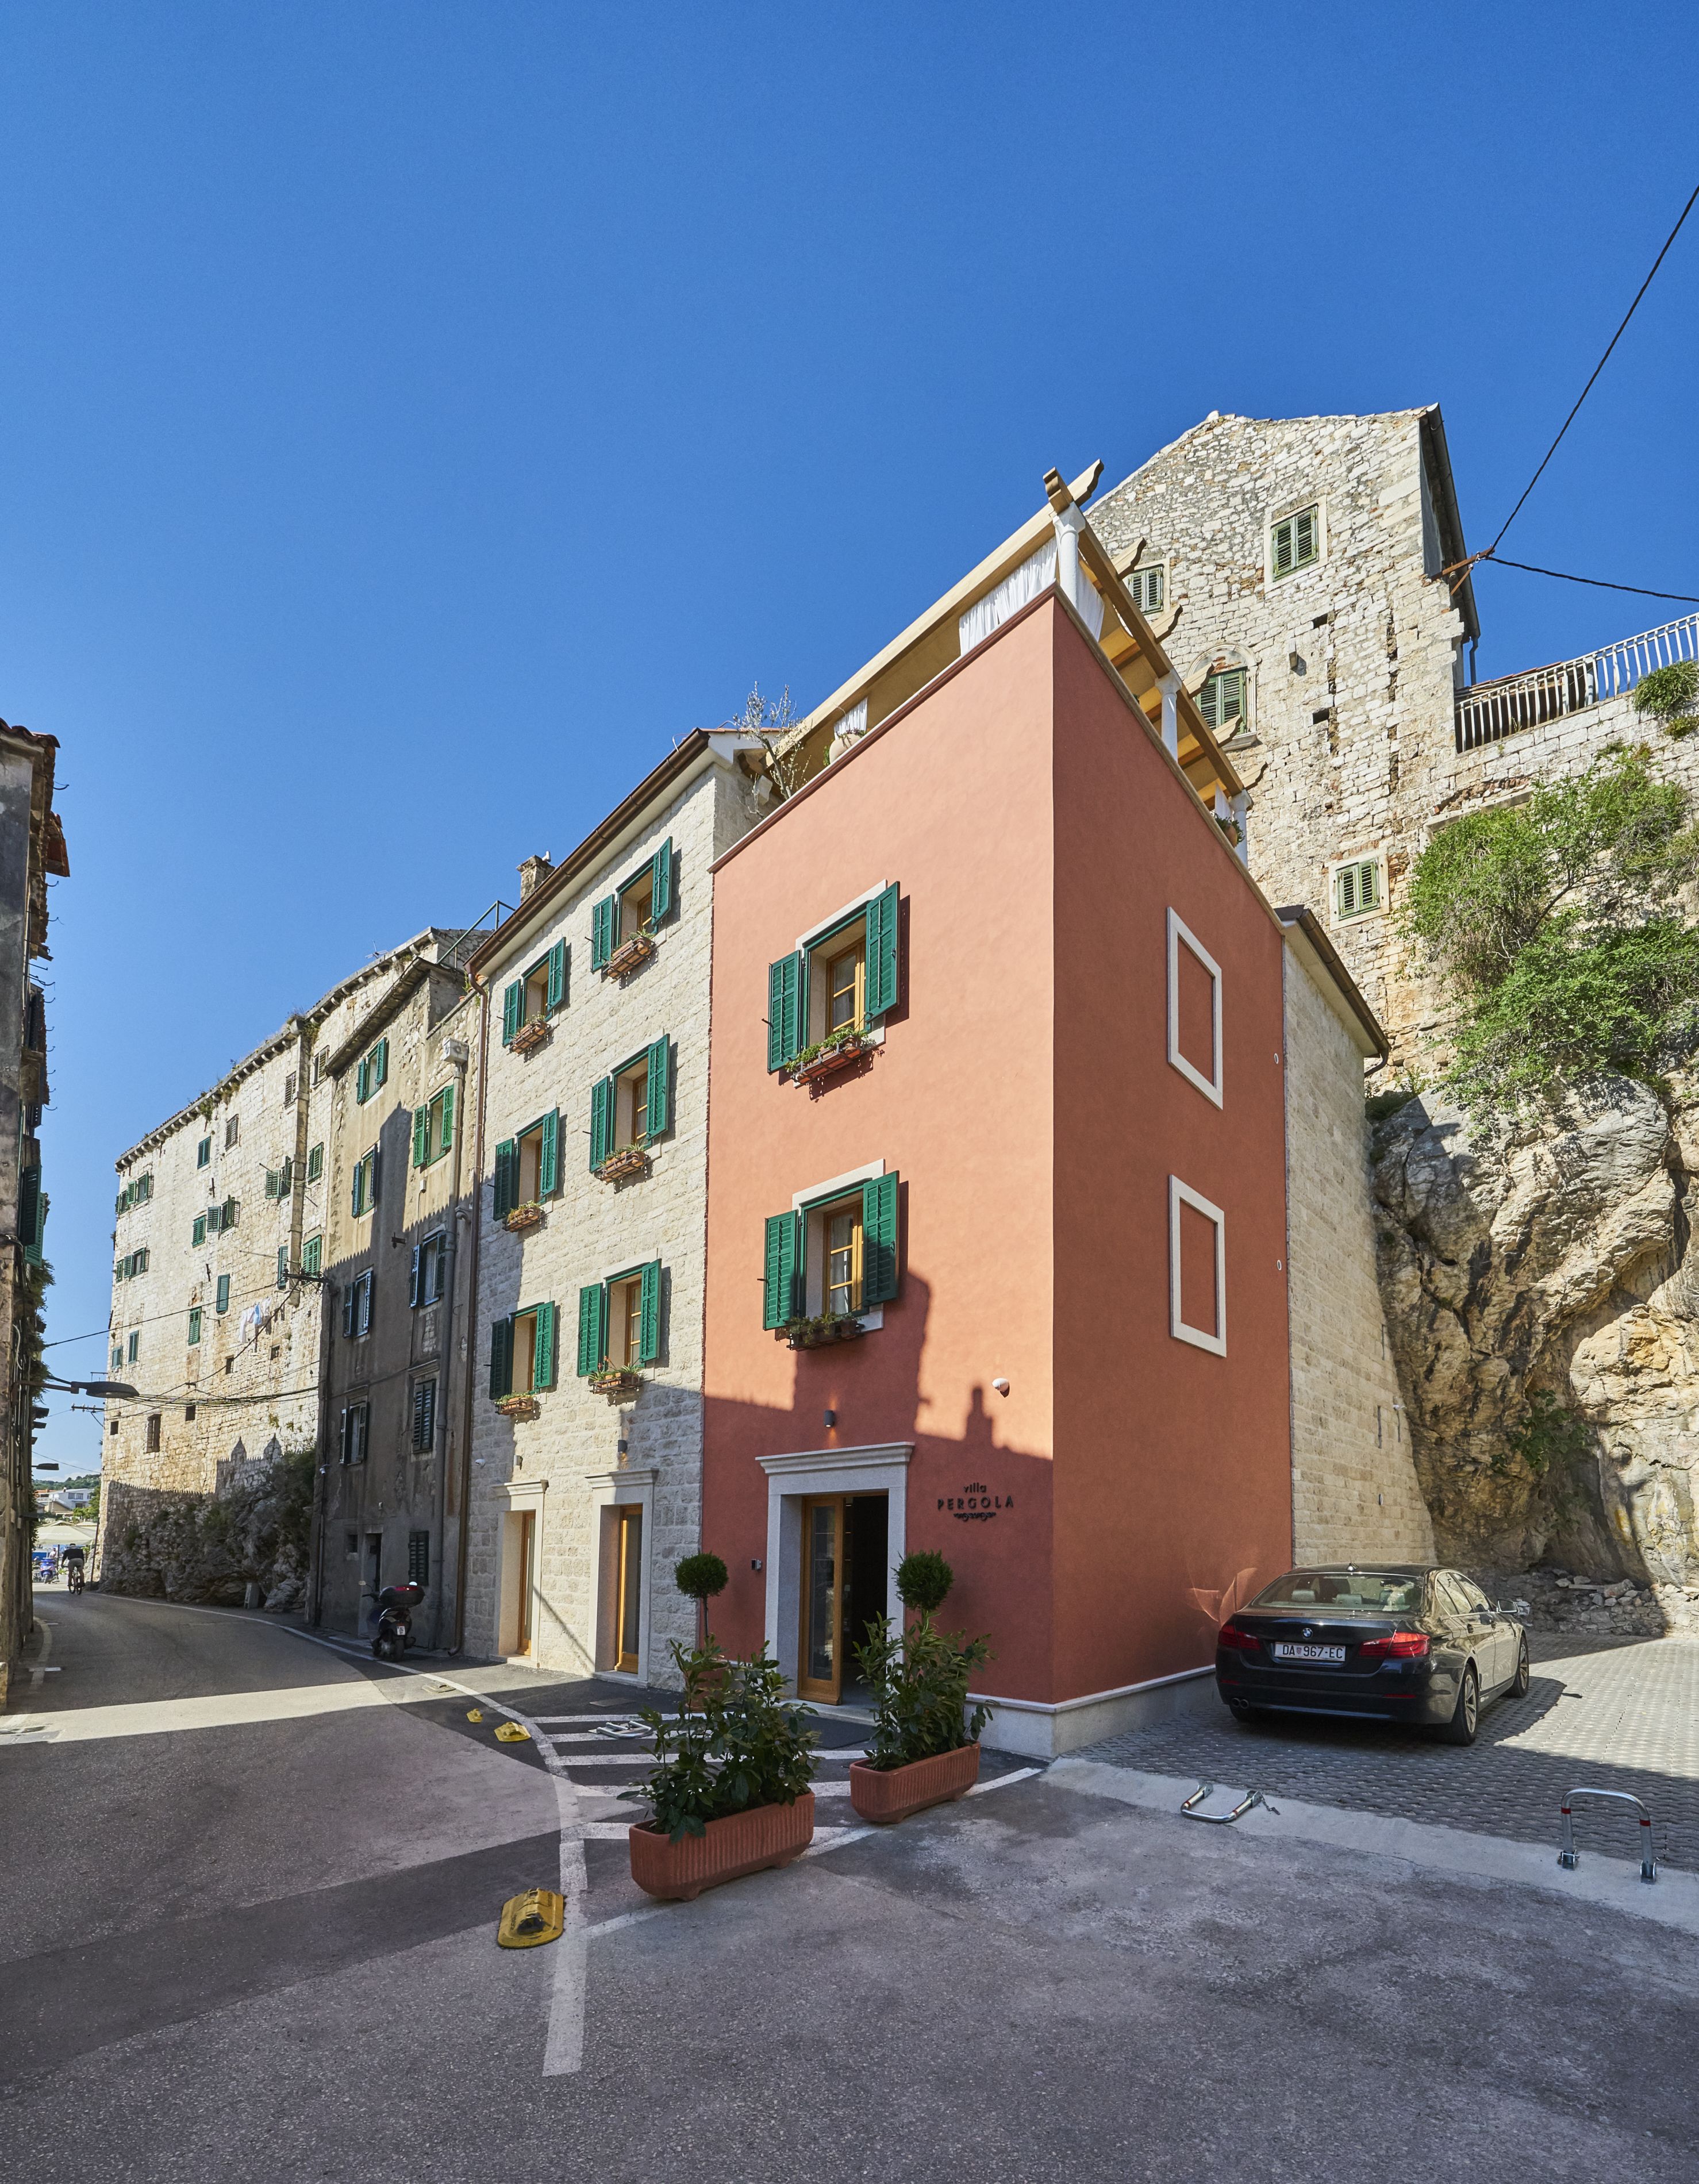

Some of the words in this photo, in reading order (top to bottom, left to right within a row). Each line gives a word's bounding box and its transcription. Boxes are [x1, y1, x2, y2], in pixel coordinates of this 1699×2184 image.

[964, 1482, 986, 1493] villa
[937, 1495, 1013, 1510] PERGOLA
[1283, 1645, 1295, 1655] DA
